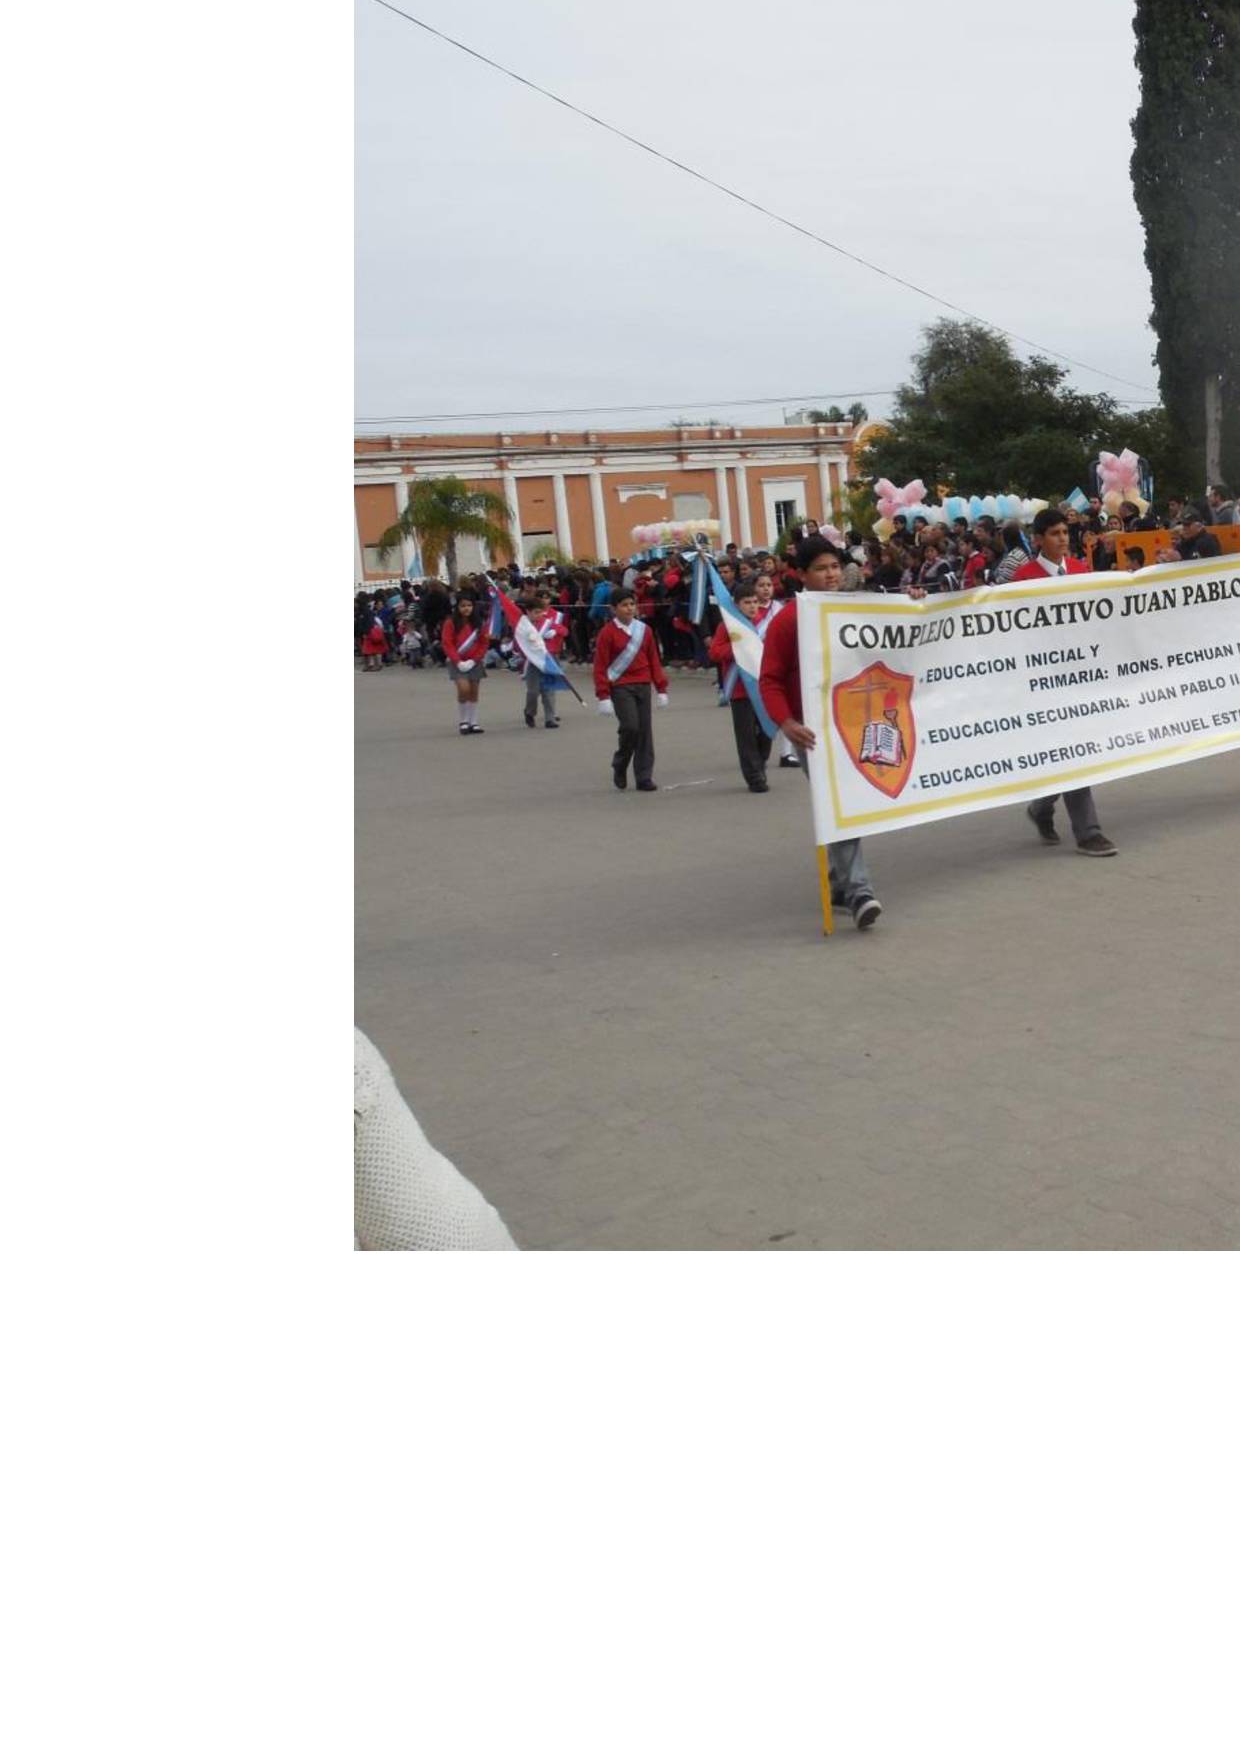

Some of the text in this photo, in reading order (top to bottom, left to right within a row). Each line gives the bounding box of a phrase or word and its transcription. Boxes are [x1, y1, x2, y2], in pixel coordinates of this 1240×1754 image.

[839, 617, 955, 650] COMPLEJO
[961, 597, 1114, 638] EDUCATIVO
[1120, 587, 1177, 617] JUAN
[926, 644, 1100, 683] EDUCACION INICIAL Y
[1029, 668, 1109, 692] PRIMARIA:
[1117, 658, 1163, 677] MONS.
[1167, 645, 1234, 668] PECHUAN
[928, 673, 1240, 744] EDUCACION SECUNDARIA: JUAN PABLO II
[919, 759, 1014, 789] EDUCACION
[1017, 741, 1103, 770] SUPERIOR:
[1106, 731, 1146, 751] JOSE
[1148, 717, 1210, 742] MANUEL
